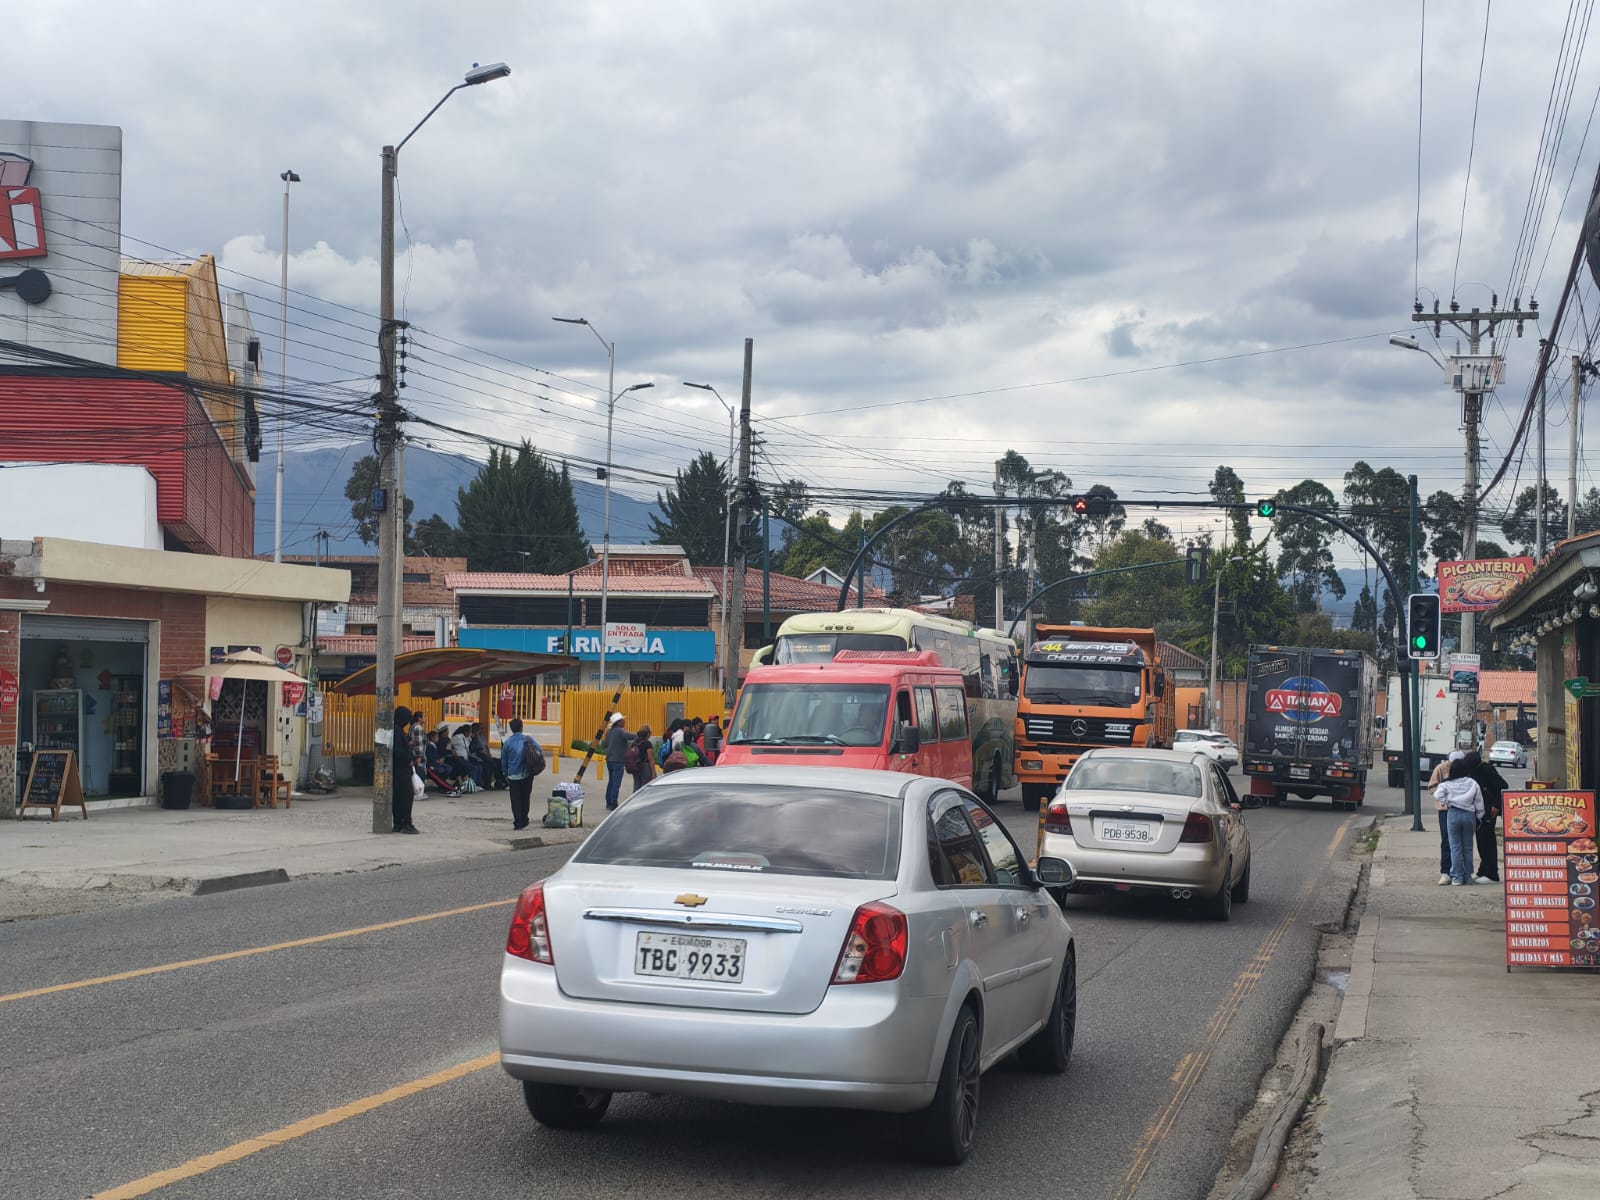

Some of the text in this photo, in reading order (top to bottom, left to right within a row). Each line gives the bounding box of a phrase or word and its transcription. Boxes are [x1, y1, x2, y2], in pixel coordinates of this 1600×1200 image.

[1041, 643, 1063, 652] 44
[1287, 695, 1333, 707] ITALIAN
[1103, 828, 1148, 840] PDB-9538
[1508, 843, 1557, 852] POLLO ASADO
[1509, 870, 1563, 879] PESCADO FRITO
[1510, 883, 1543, 892] CHULETA
[1510, 897, 1527, 905] SECOS
[1510, 910, 1545, 919] BOLONES
[1511, 923, 1548, 933] DESAYUNOS
[671, 937, 712, 948] ECUADOR
[1511, 938, 1550, 947] ALMUERZOS
[1511, 952, 1564, 962] BEBIDAS Y MÁS
[640, 947, 740, 977] TBC 9933
